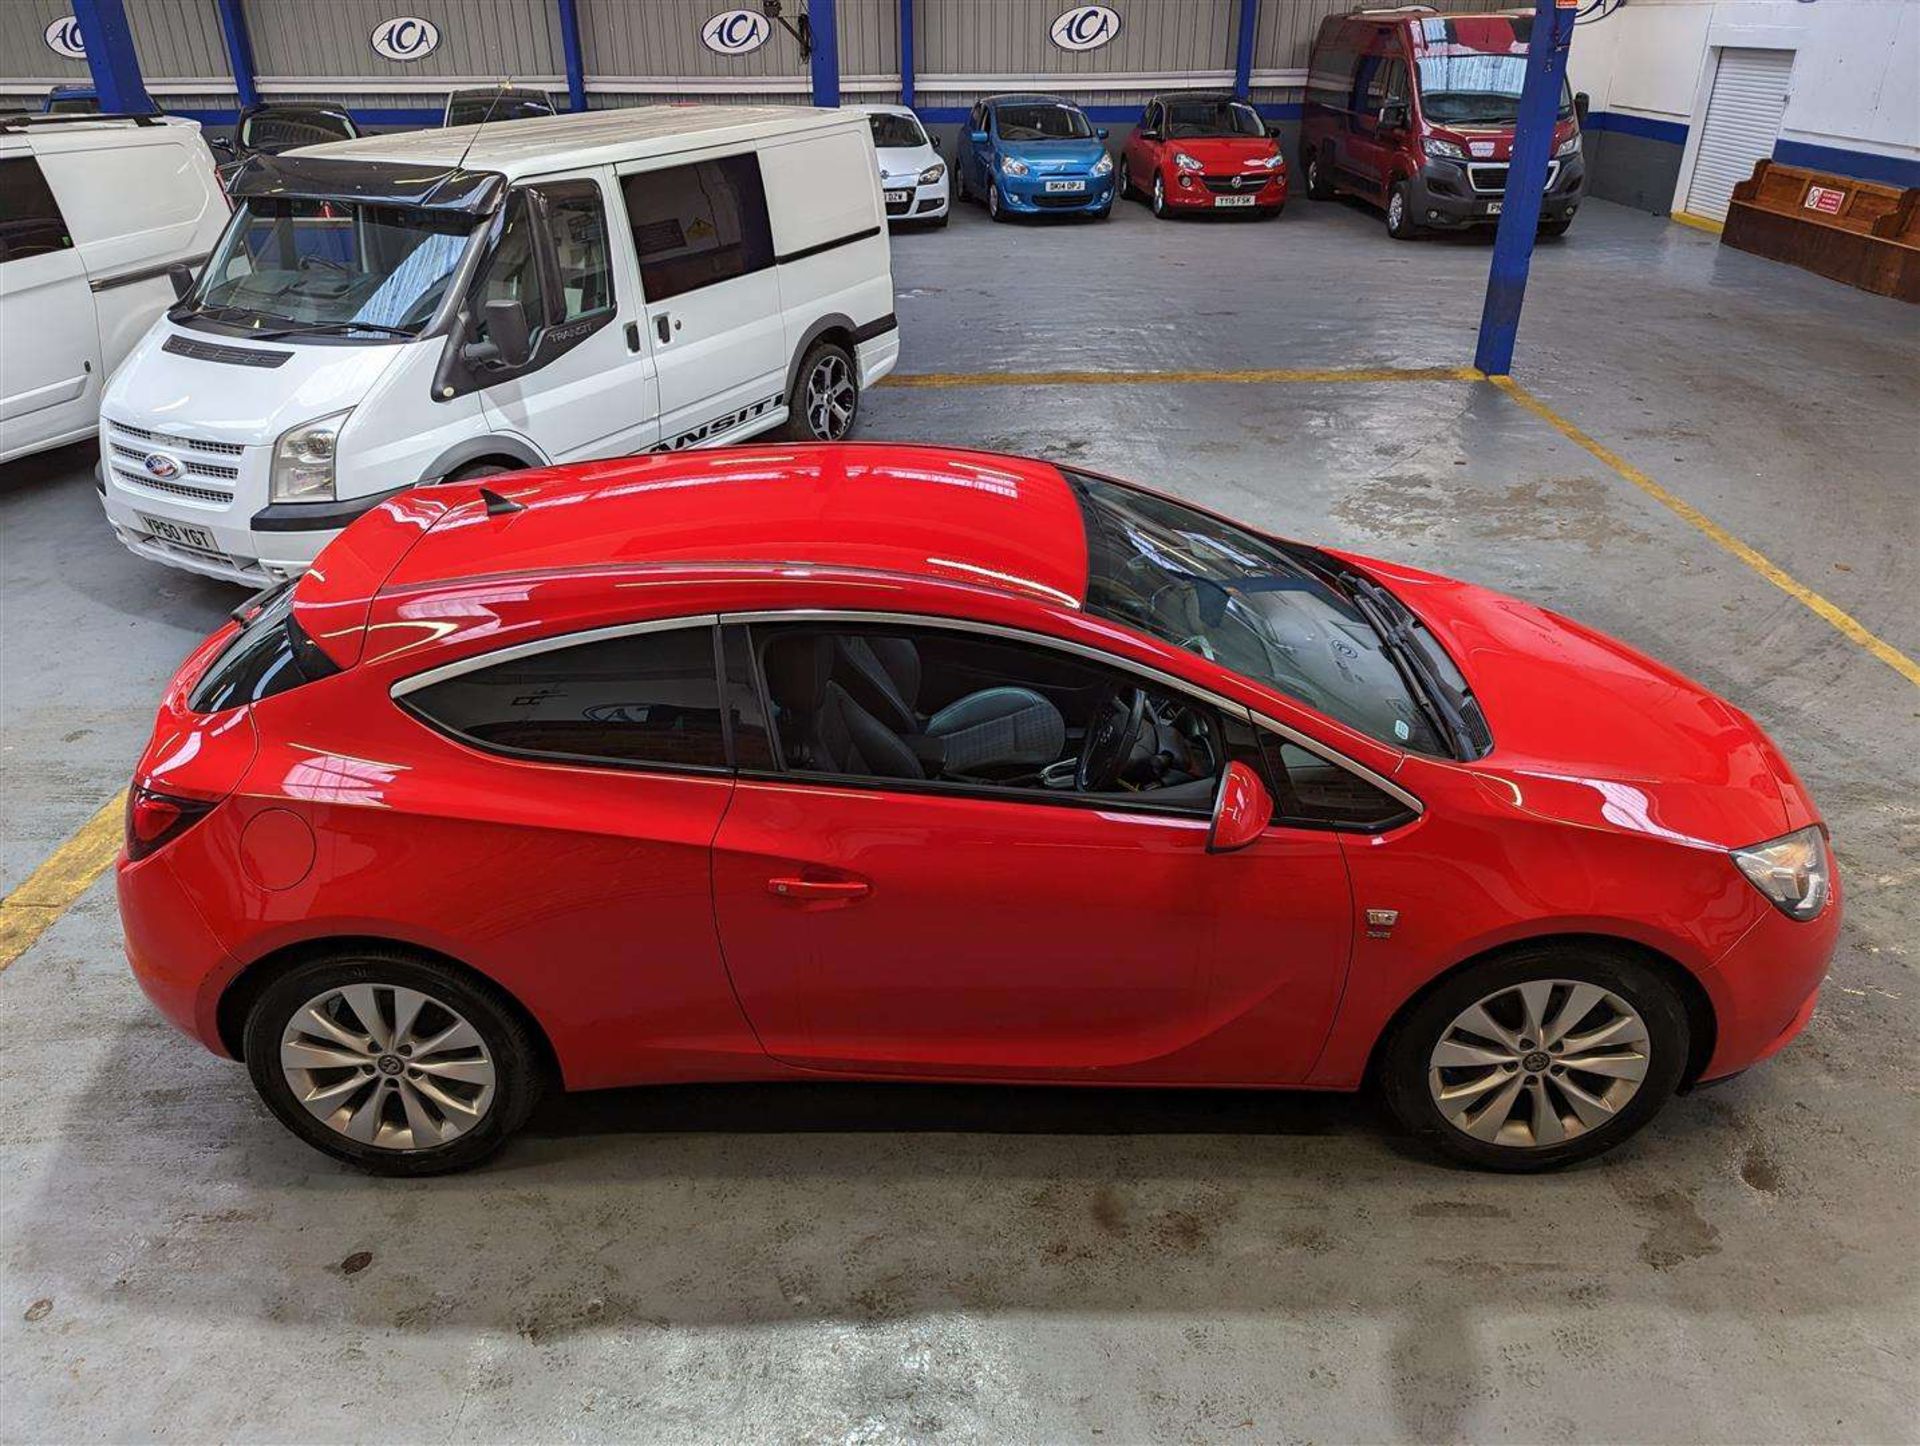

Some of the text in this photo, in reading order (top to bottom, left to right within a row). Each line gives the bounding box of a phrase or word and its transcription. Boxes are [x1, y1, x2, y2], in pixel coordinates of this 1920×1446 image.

[50, 22, 84, 52] AC
[376, 20, 431, 54] ACA
[706, 14, 761, 48] ACA
[1054, 9, 1109, 44] ACA
[650, 398, 772, 453] ANSIT
[143, 516, 210, 548] YP60 YGT
